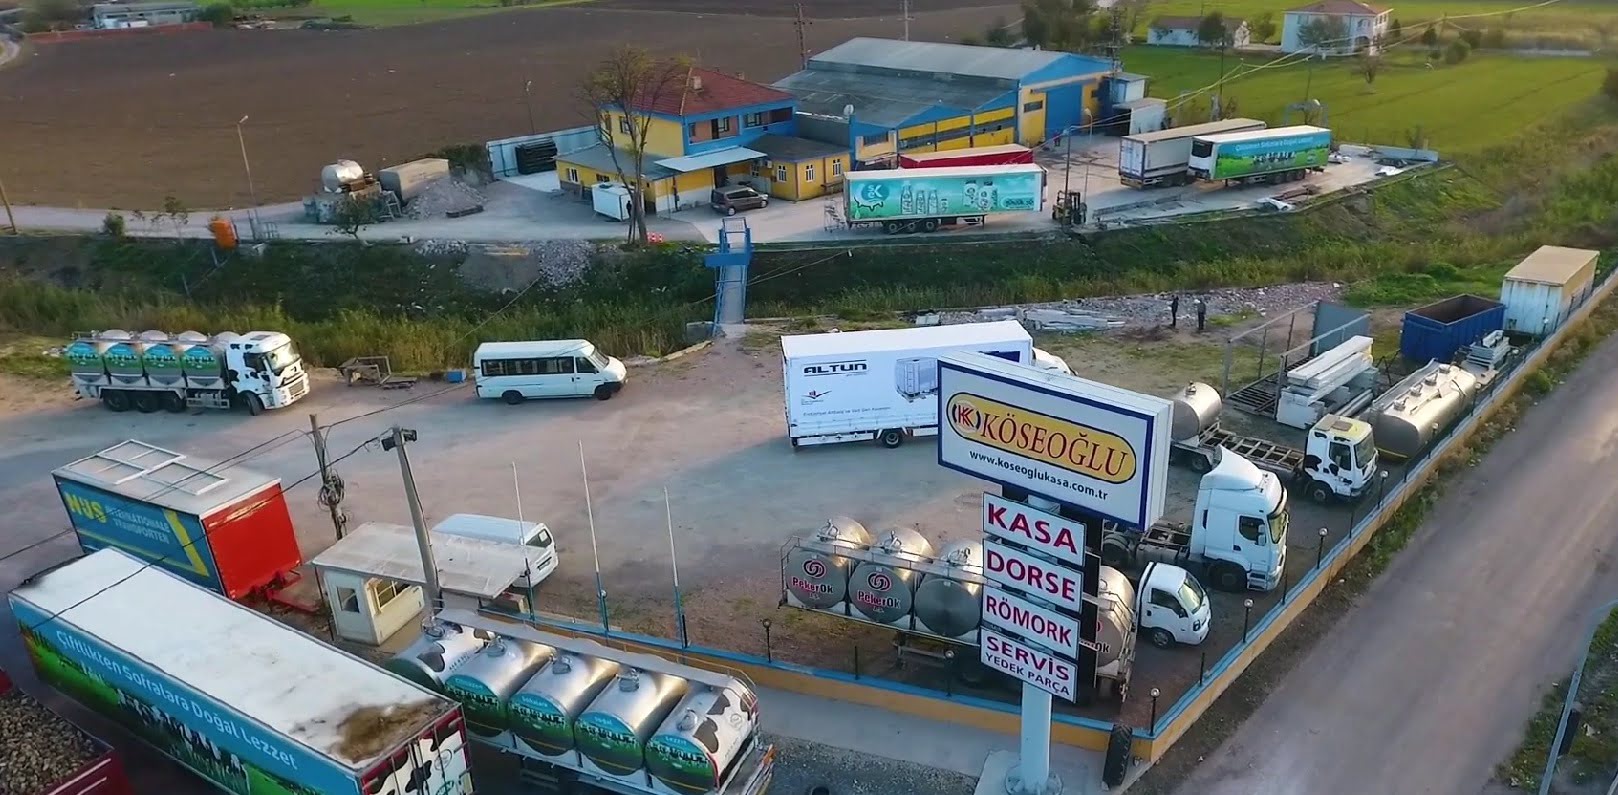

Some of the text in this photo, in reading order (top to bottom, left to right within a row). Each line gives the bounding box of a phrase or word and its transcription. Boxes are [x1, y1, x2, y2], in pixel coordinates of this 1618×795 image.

[803, 363, 867, 374] ALTUN
[981, 411, 1129, 477] KÖSEOĞLU
[969, 450, 1108, 501] www.koseoglukasa.com.tr
[987, 502, 1079, 555] KASA
[986, 549, 1076, 602] DORSE
[986, 595, 1073, 648] RÖMORK
[985, 652, 1070, 696] YEDEK PARÇA
[986, 636, 1071, 681] SERVİS
[190, 700, 241, 739] Doğal
[240, 727, 299, 771] Lezzet
